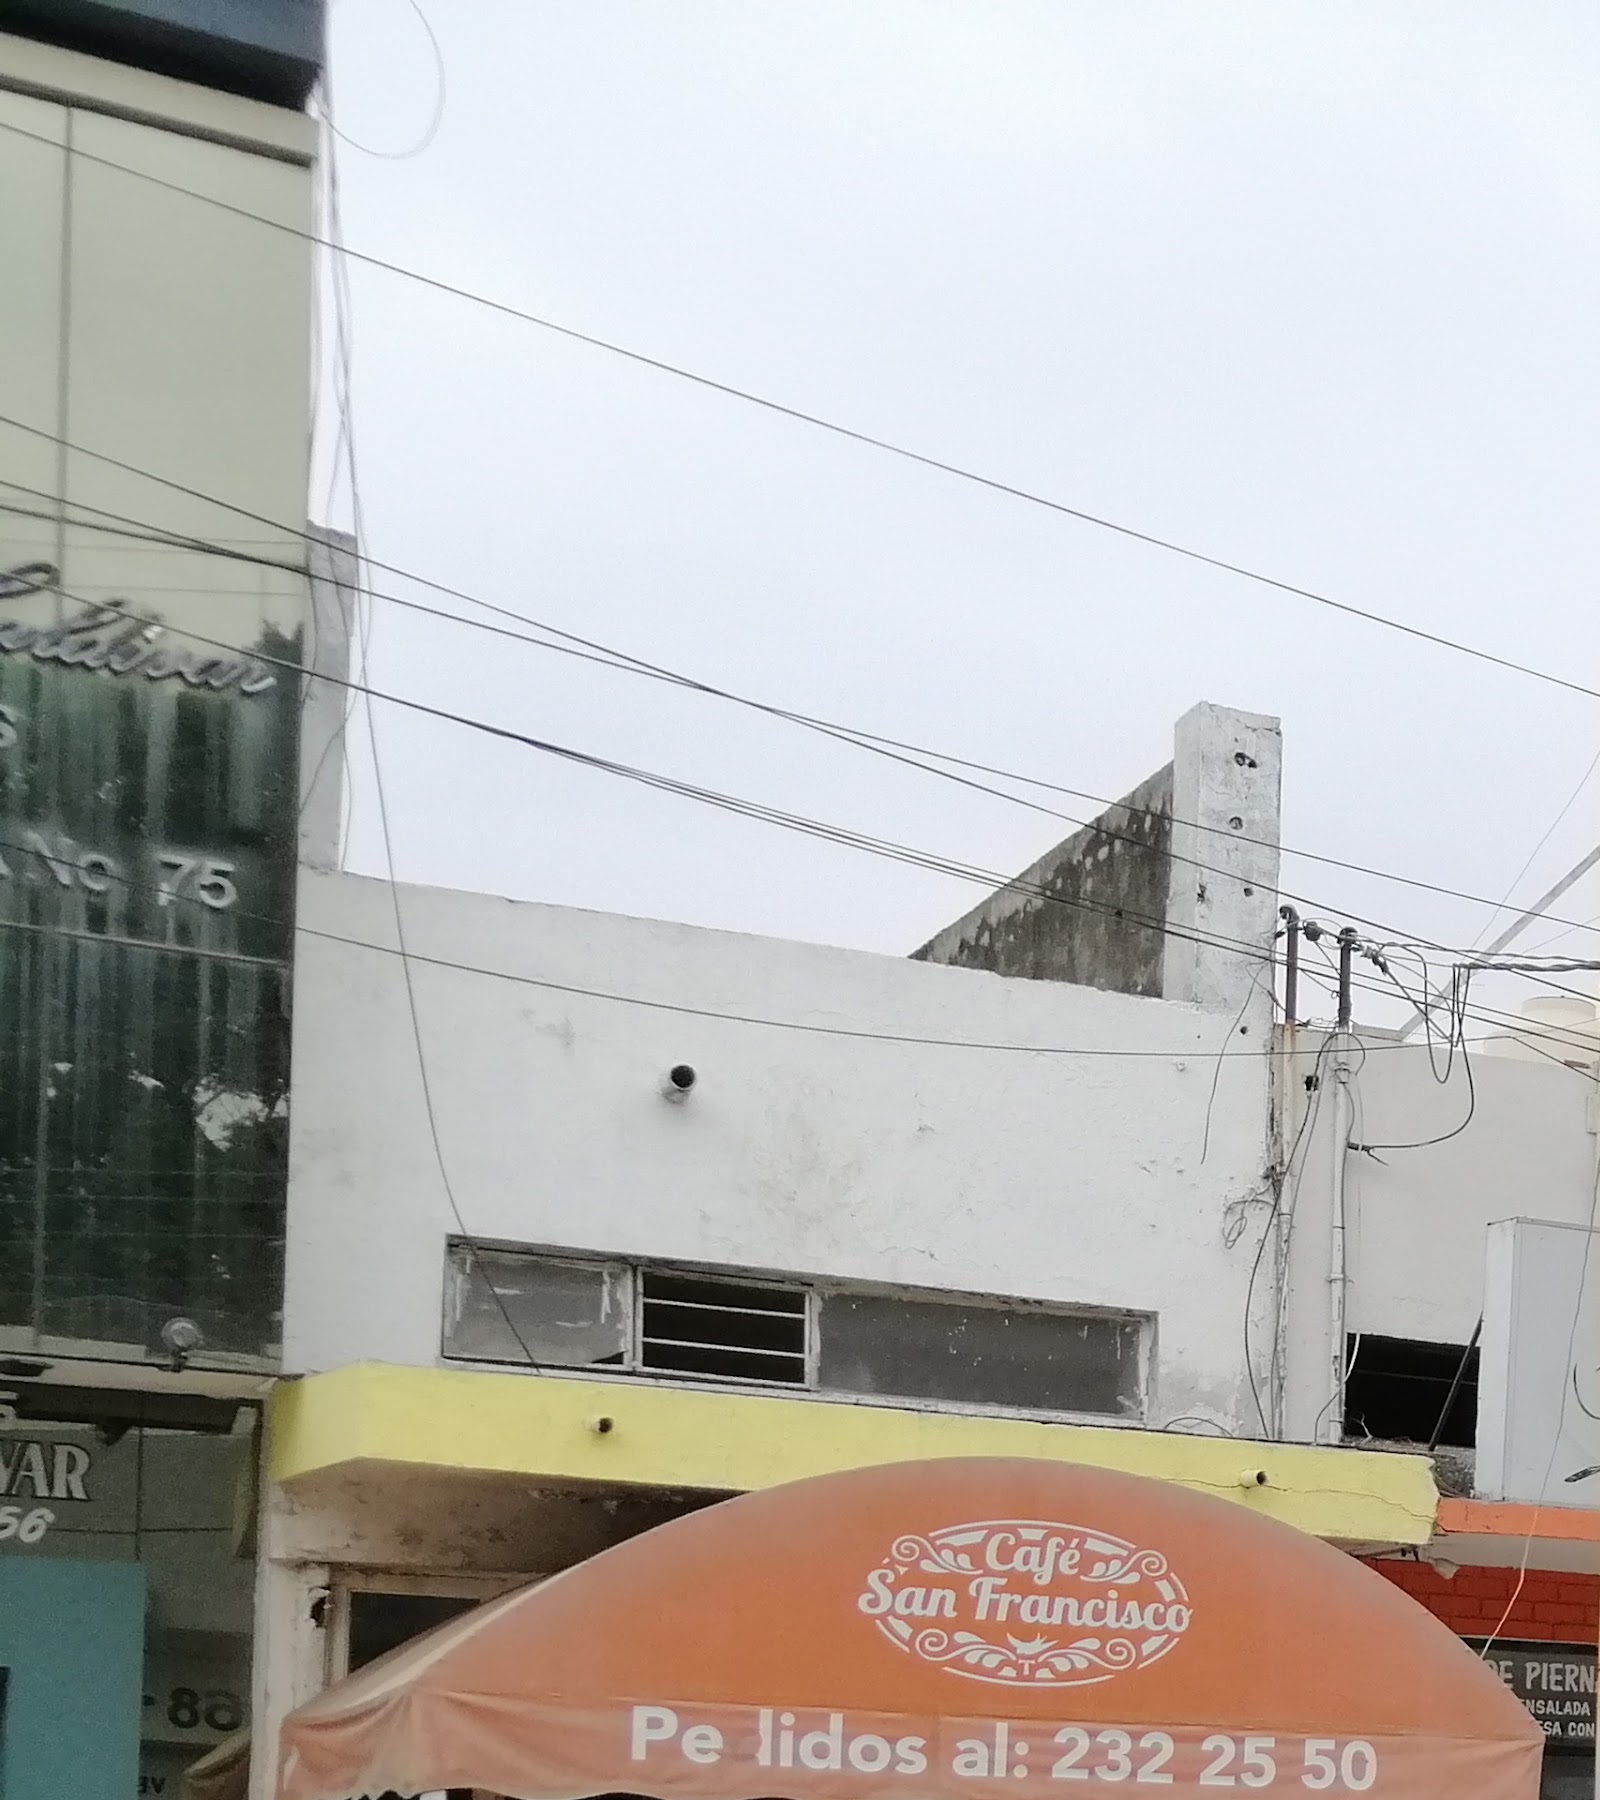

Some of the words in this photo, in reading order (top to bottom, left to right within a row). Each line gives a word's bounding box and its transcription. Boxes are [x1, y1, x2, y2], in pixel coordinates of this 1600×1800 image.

[985, 1532, 1081, 1585] Café
[858, 1568, 957, 1618] San
[968, 1576, 1194, 1633] Francisco
[1525, 1661, 1599, 1694] PIERN
[951, 1721, 1030, 1779] al:
[1051, 1726, 1174, 1784] 232
[1200, 1734, 1277, 1788] 25
[1301, 1738, 1378, 1791] 50
